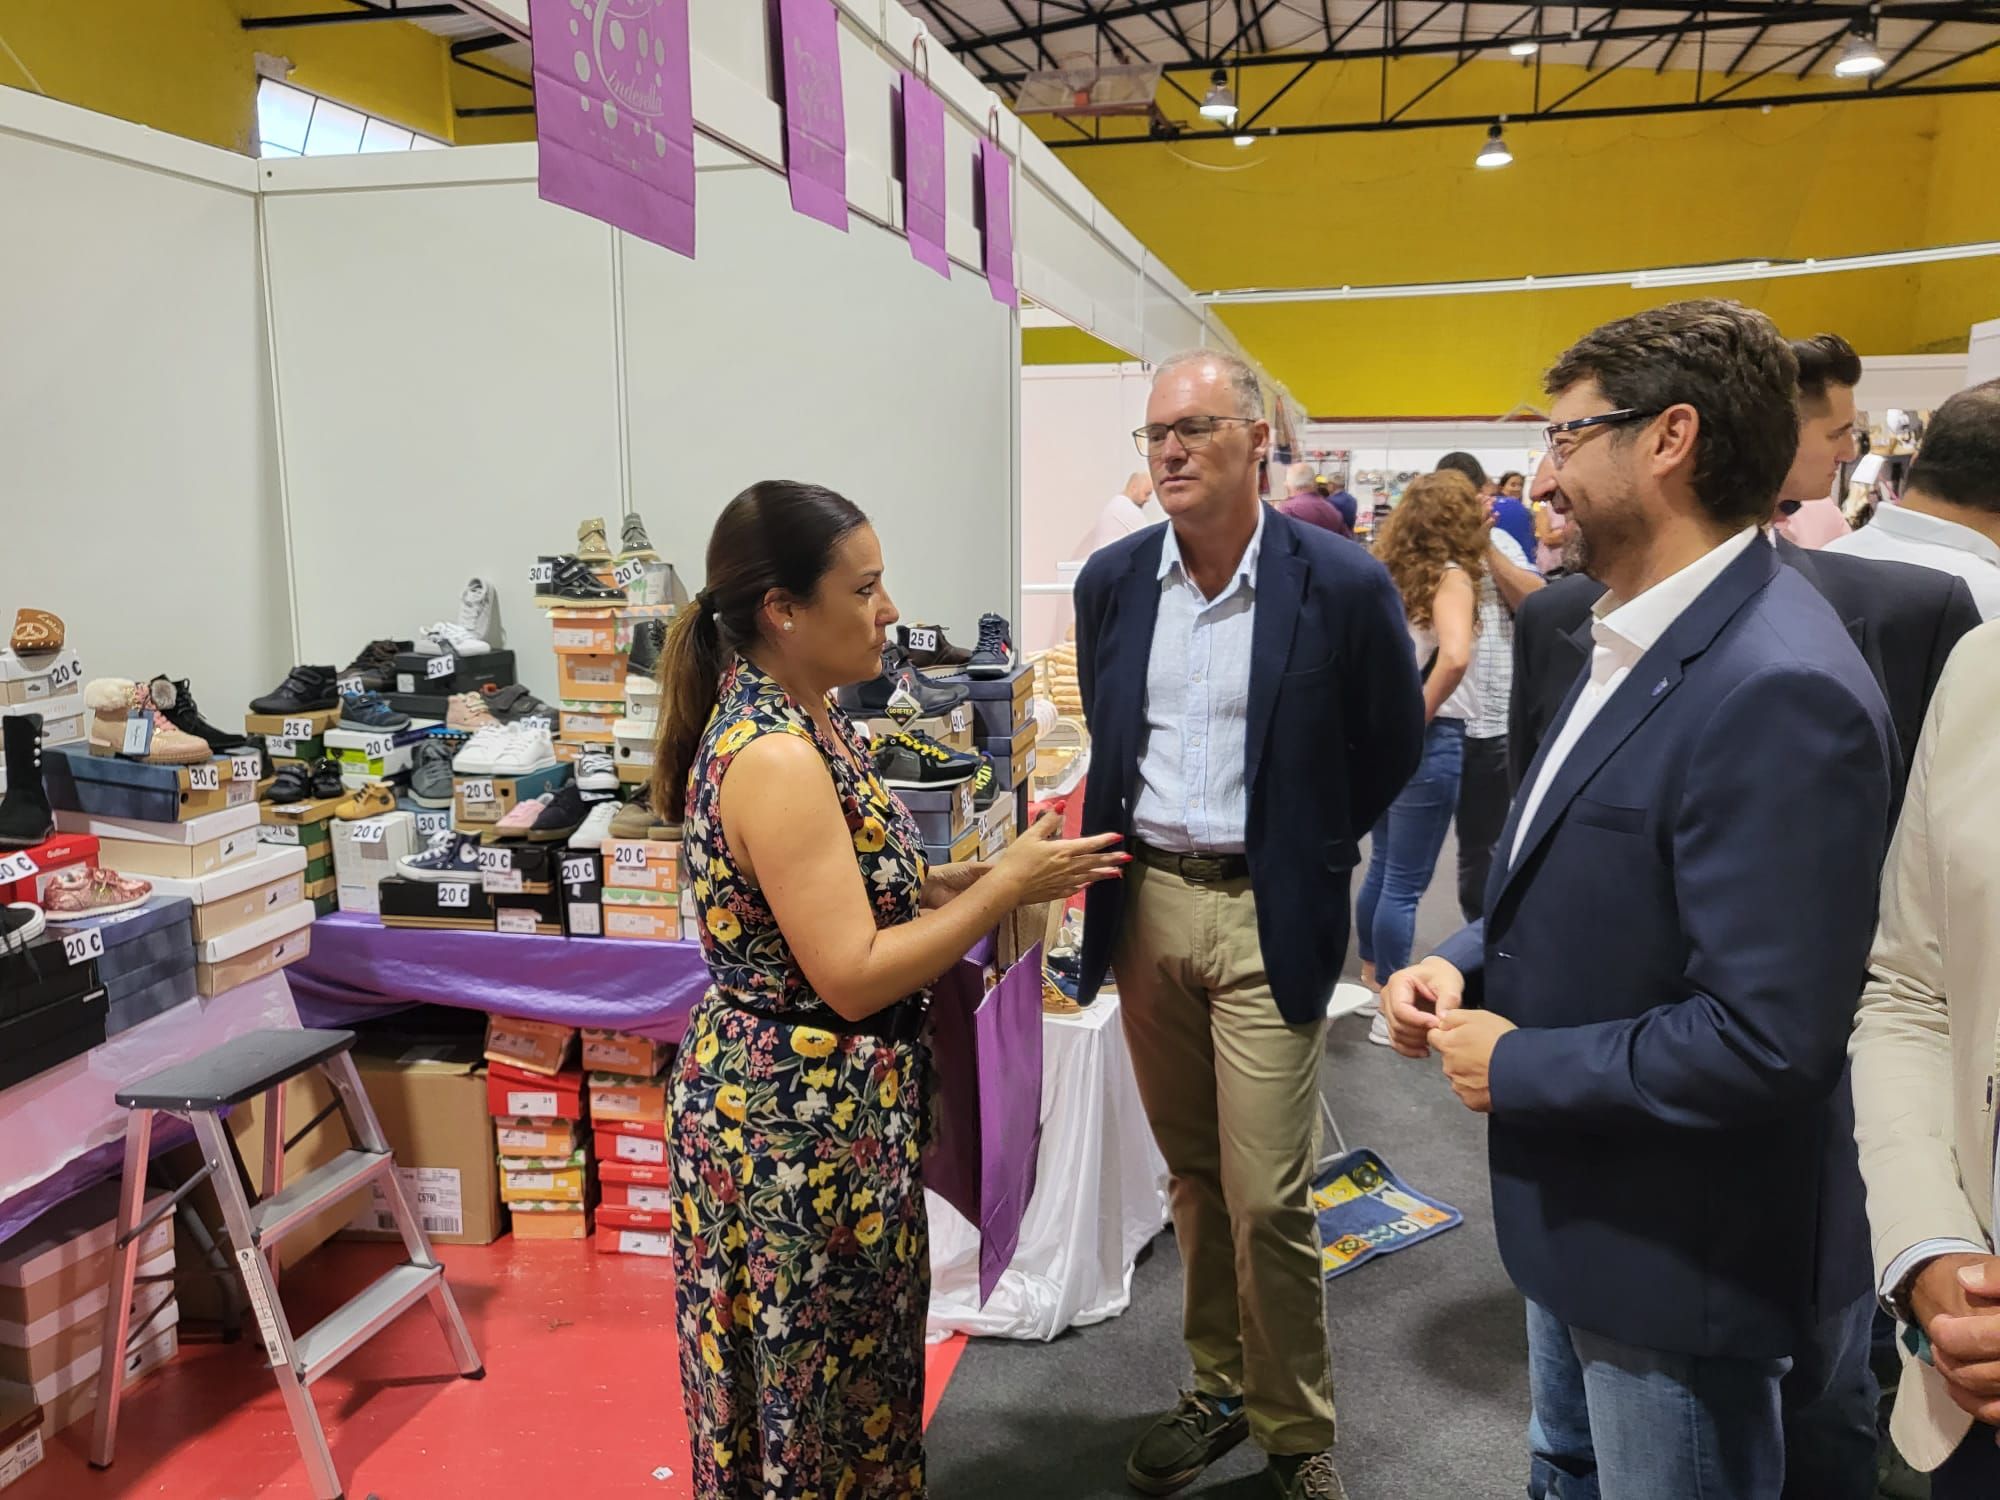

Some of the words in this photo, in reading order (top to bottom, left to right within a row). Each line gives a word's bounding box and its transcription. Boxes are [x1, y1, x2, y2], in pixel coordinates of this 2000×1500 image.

[529, 566, 543, 581] 30
[615, 567, 632, 585] 20
[909, 632, 924, 646] 25
[927, 634, 935, 648] €
[52, 665, 70, 684] 20
[430, 662, 443, 675] 20
[285, 723, 299, 736] 25
[366, 741, 380, 755] 20
[234, 761, 248, 777] 25
[191, 769, 207, 785] 30
[466, 784, 480, 798] 20
[353, 825, 370, 838] 20
[420, 817, 435, 831] 30
[480, 852, 496, 867] 20
[615, 848, 632, 863] 20
[0, 863, 15, 879] 0
[562, 864, 580, 880] 20
[439, 888, 456, 903] 20
[67, 938, 86, 960] 20
